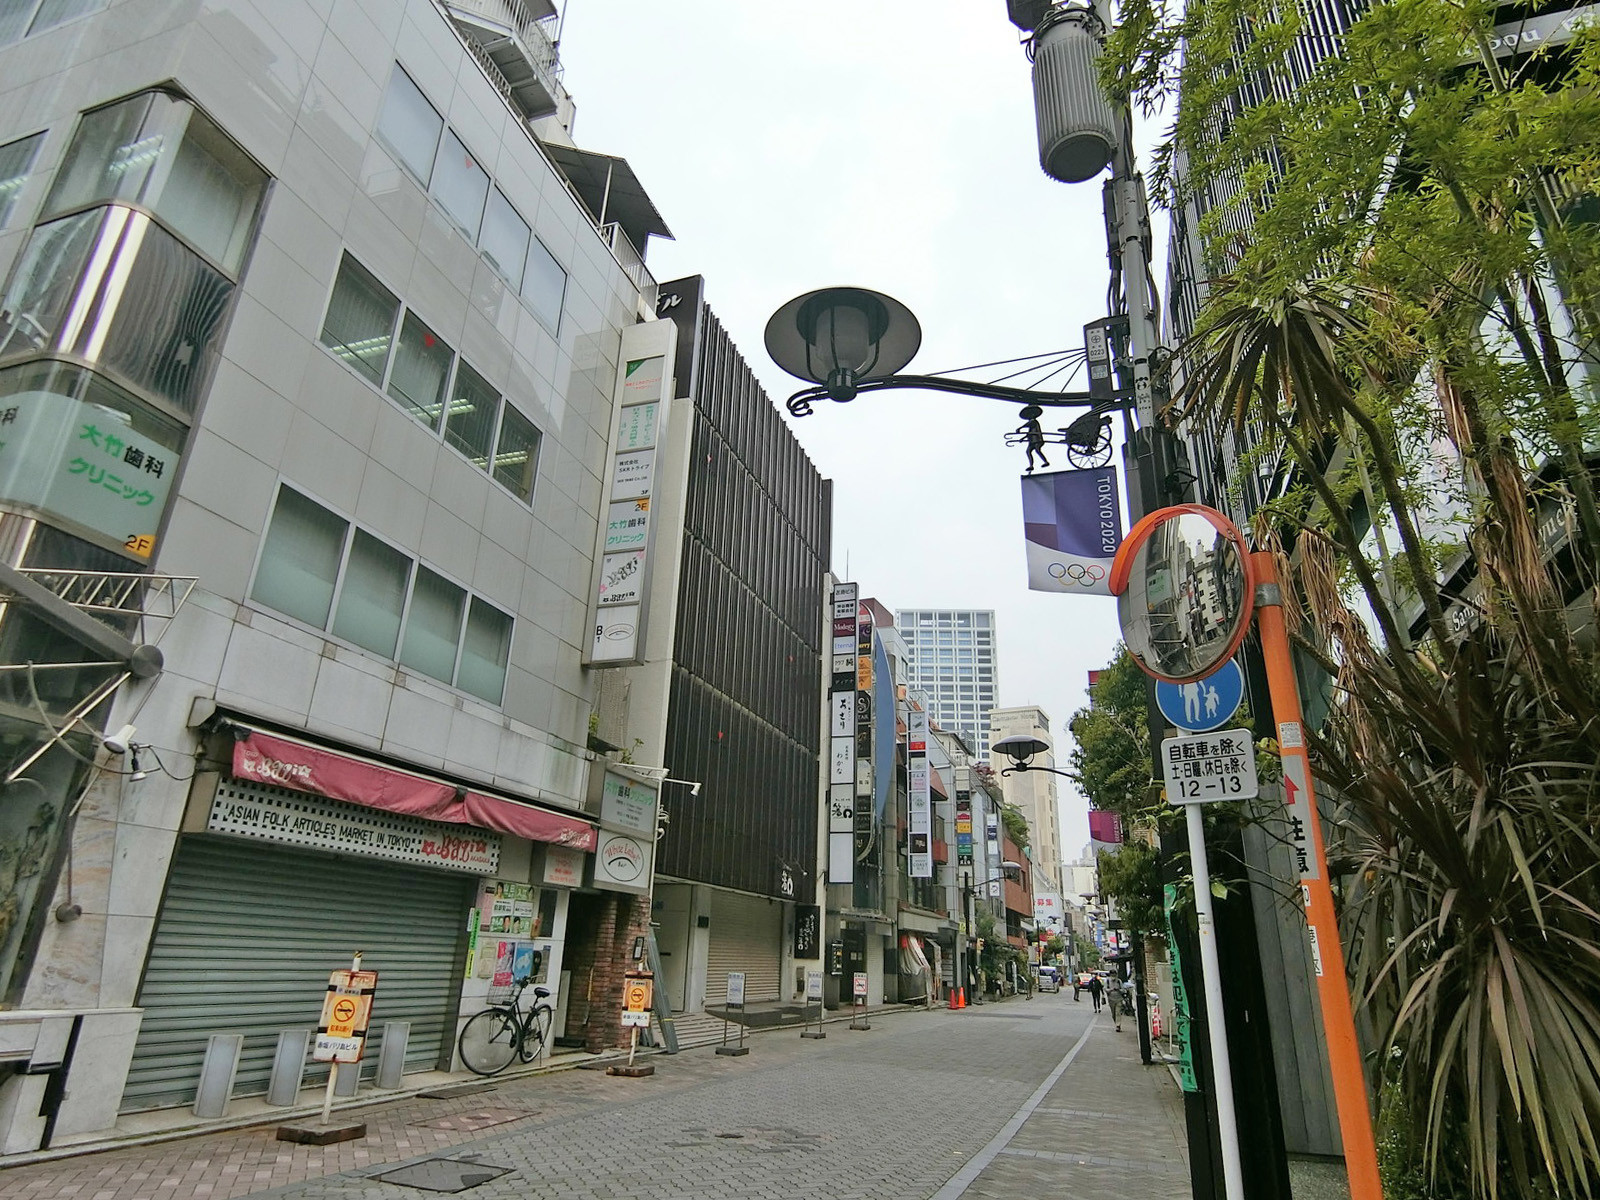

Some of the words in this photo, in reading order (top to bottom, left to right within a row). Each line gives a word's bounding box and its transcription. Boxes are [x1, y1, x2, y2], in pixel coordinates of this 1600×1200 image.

[1089, 349, 1105, 357] 0223
[79, 423, 165, 479] 大竹歯科
[68, 456, 156, 507] クリニック
[634, 503, 648, 512] 2F
[1096, 475, 1113, 519] TOKYO
[608, 516, 647, 529] 大竹歯科
[125, 534, 150, 551] 2F
[607, 532, 645, 546] クリニック
[1100, 521, 1117, 553] 2020
[1169, 737, 1246, 761] 自転車を除く
[1171, 757, 1248, 780] 土・日曜、休日を除く
[605, 779, 654, 806] 大竹歯科クリニック
[228, 804, 261, 823] ASIAN
[262, 811, 291, 827] FOLK
[292, 817, 337, 836] ARTICLES
[339, 825, 374, 843] MARKET
[376, 832, 385, 844] IN
[387, 834, 412, 849] TOKYO
[1036, 898, 1054, 907] 募集
